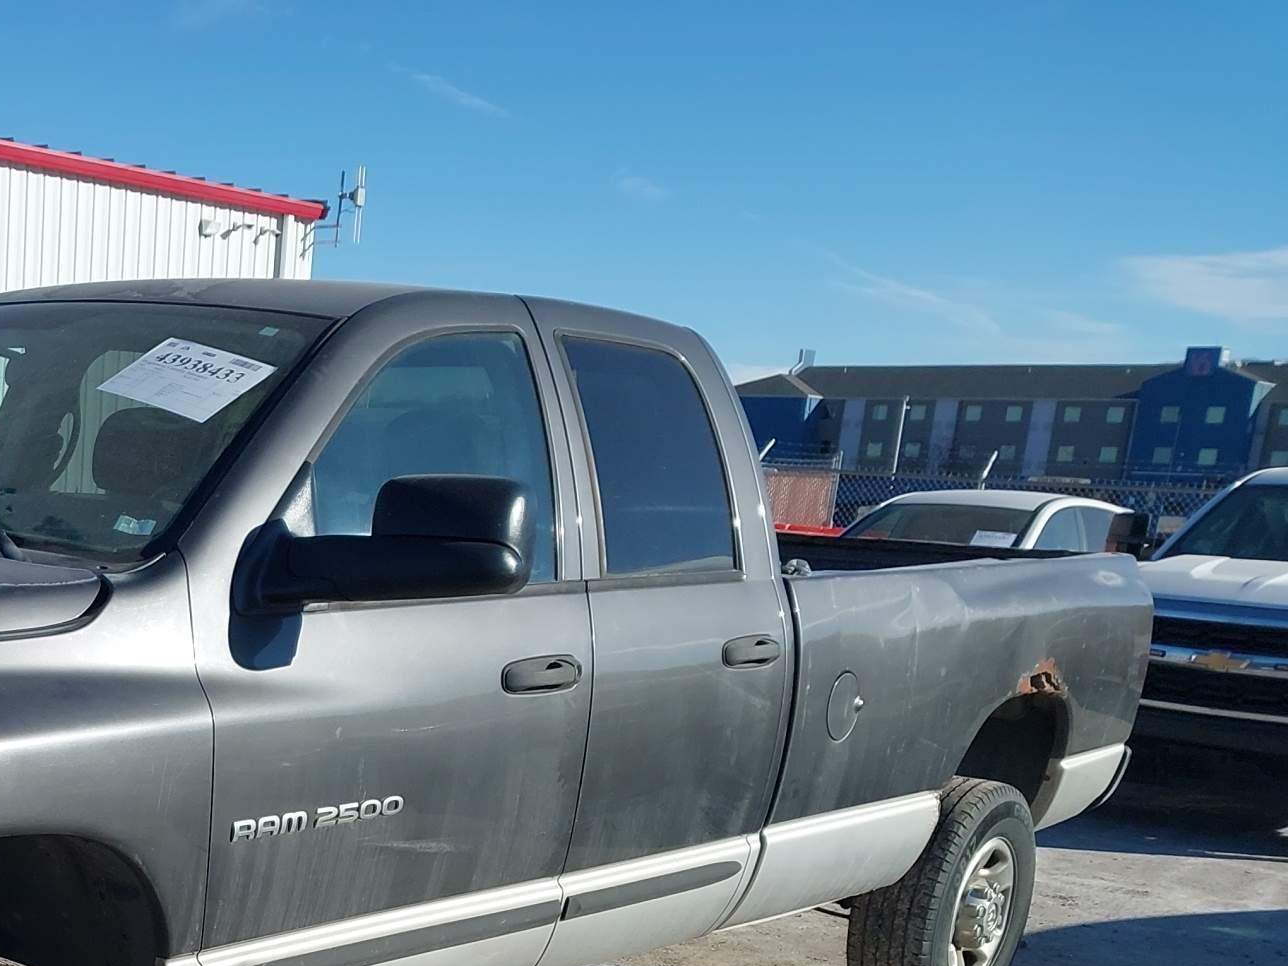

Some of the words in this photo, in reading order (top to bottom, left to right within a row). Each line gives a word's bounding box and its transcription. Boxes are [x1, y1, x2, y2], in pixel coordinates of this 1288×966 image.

[155, 352, 245, 384] 43938433
[230, 810, 309, 843] RAM
[314, 795, 404, 829] 2500
